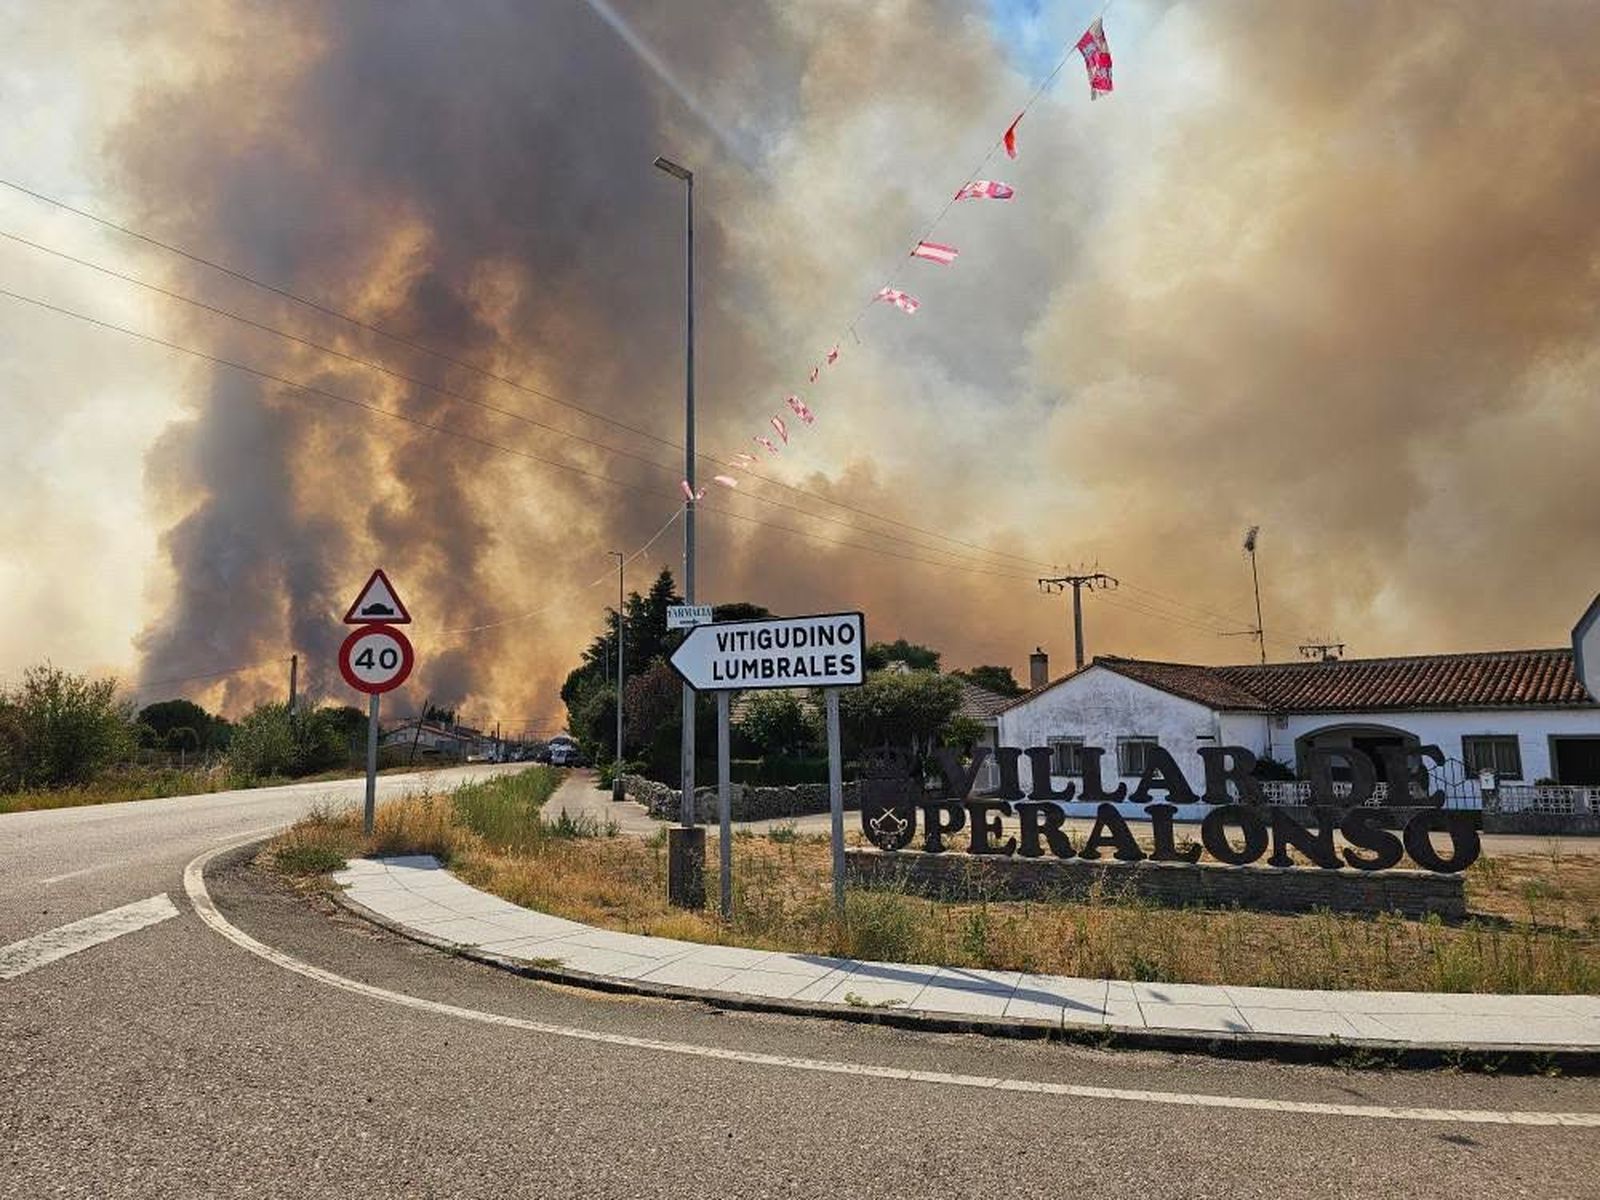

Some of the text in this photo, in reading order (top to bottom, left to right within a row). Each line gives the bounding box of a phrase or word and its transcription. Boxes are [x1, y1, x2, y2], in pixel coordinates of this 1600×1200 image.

[716, 623, 855, 652] VITIGUDINO
[355, 648, 398, 670] 40
[713, 654, 856, 681] LUMBRALES
[934, 744, 1446, 808] VILLAR DE
[921, 801, 1482, 873] PERALONSO
